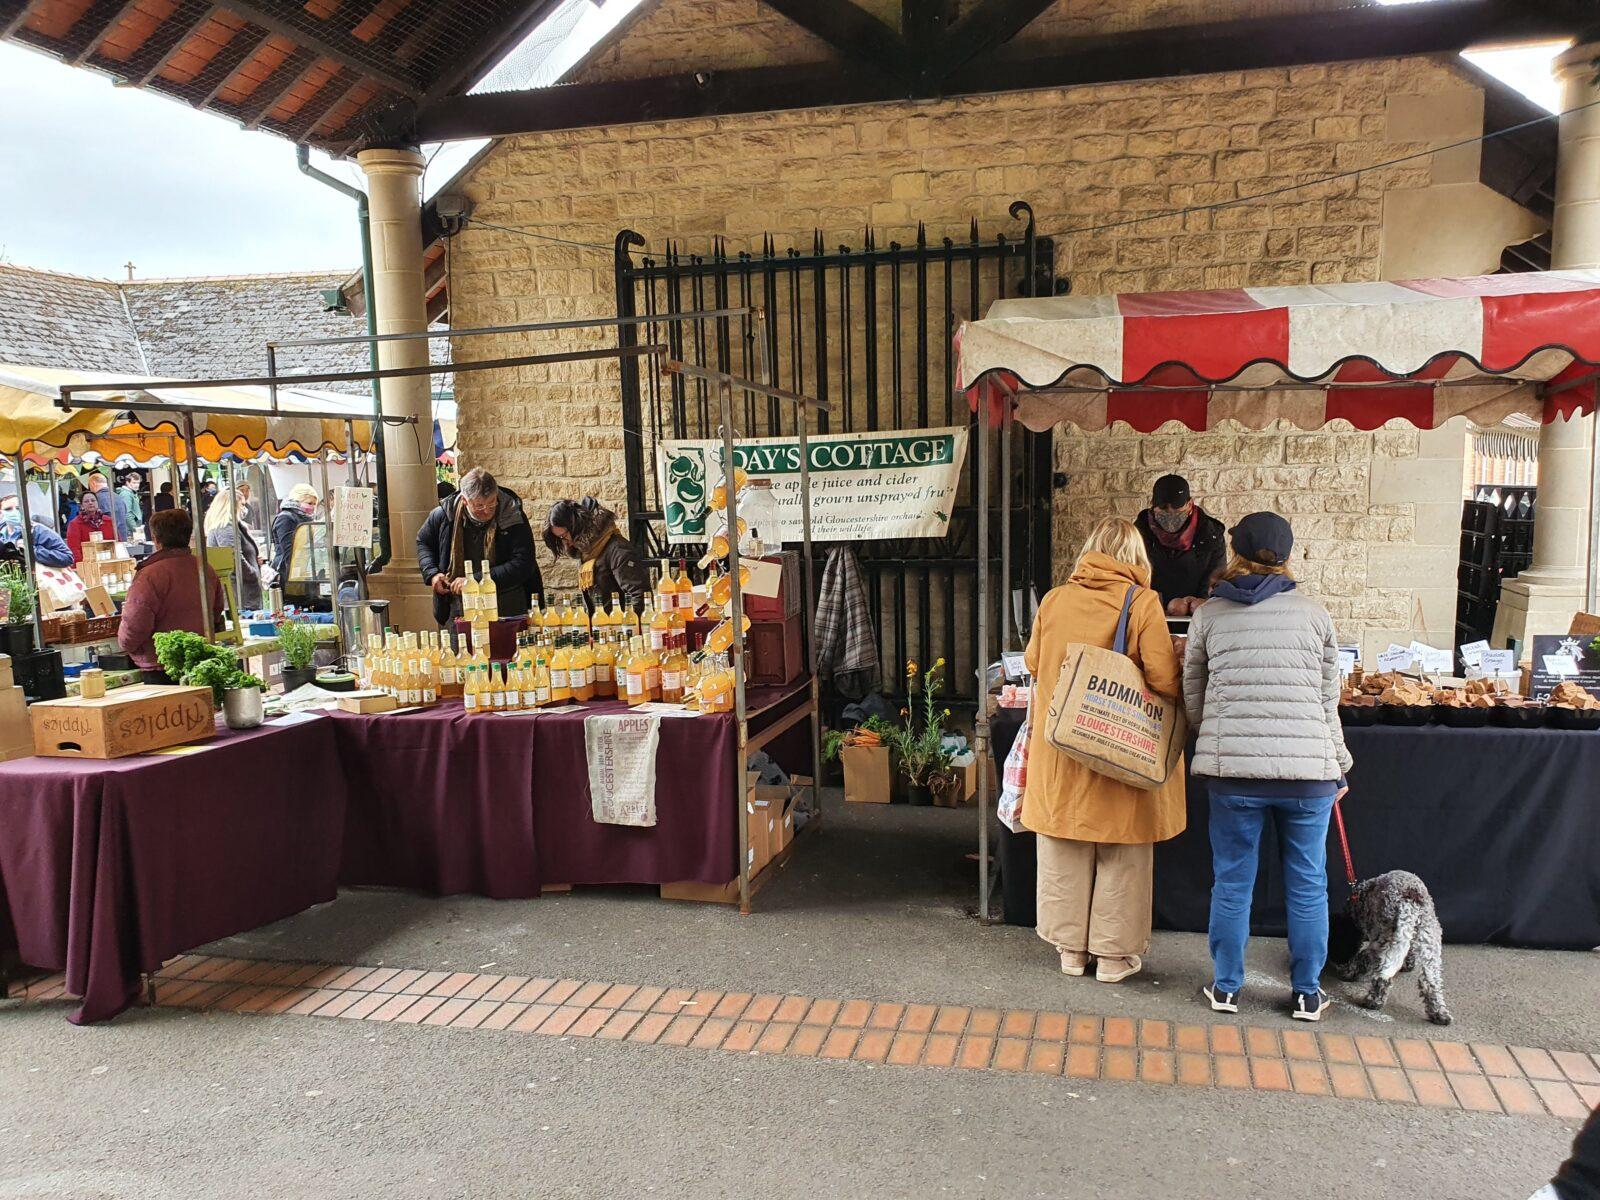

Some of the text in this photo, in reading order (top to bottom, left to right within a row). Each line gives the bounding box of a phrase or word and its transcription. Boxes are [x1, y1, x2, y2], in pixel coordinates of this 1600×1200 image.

[732, 439, 946, 470] DAY'S COTTAGE
[785, 477, 819, 492] aple
[821, 476, 853, 491] juice
[856, 474, 882, 487] and
[885, 473, 918, 486] cider
[813, 495, 853, 507] grown
[826, 513, 889, 524] Gloucestershire
[817, 525, 836, 534] their
[839, 524, 871, 534] wildlife
[119, 703, 204, 740] Apples
[618, 718, 649, 733] APPLES
[1111, 713, 1122, 722] TEST
[43, 716, 92, 737] Apples
[1076, 714, 1157, 754] GLOUCESTERSHIRE
